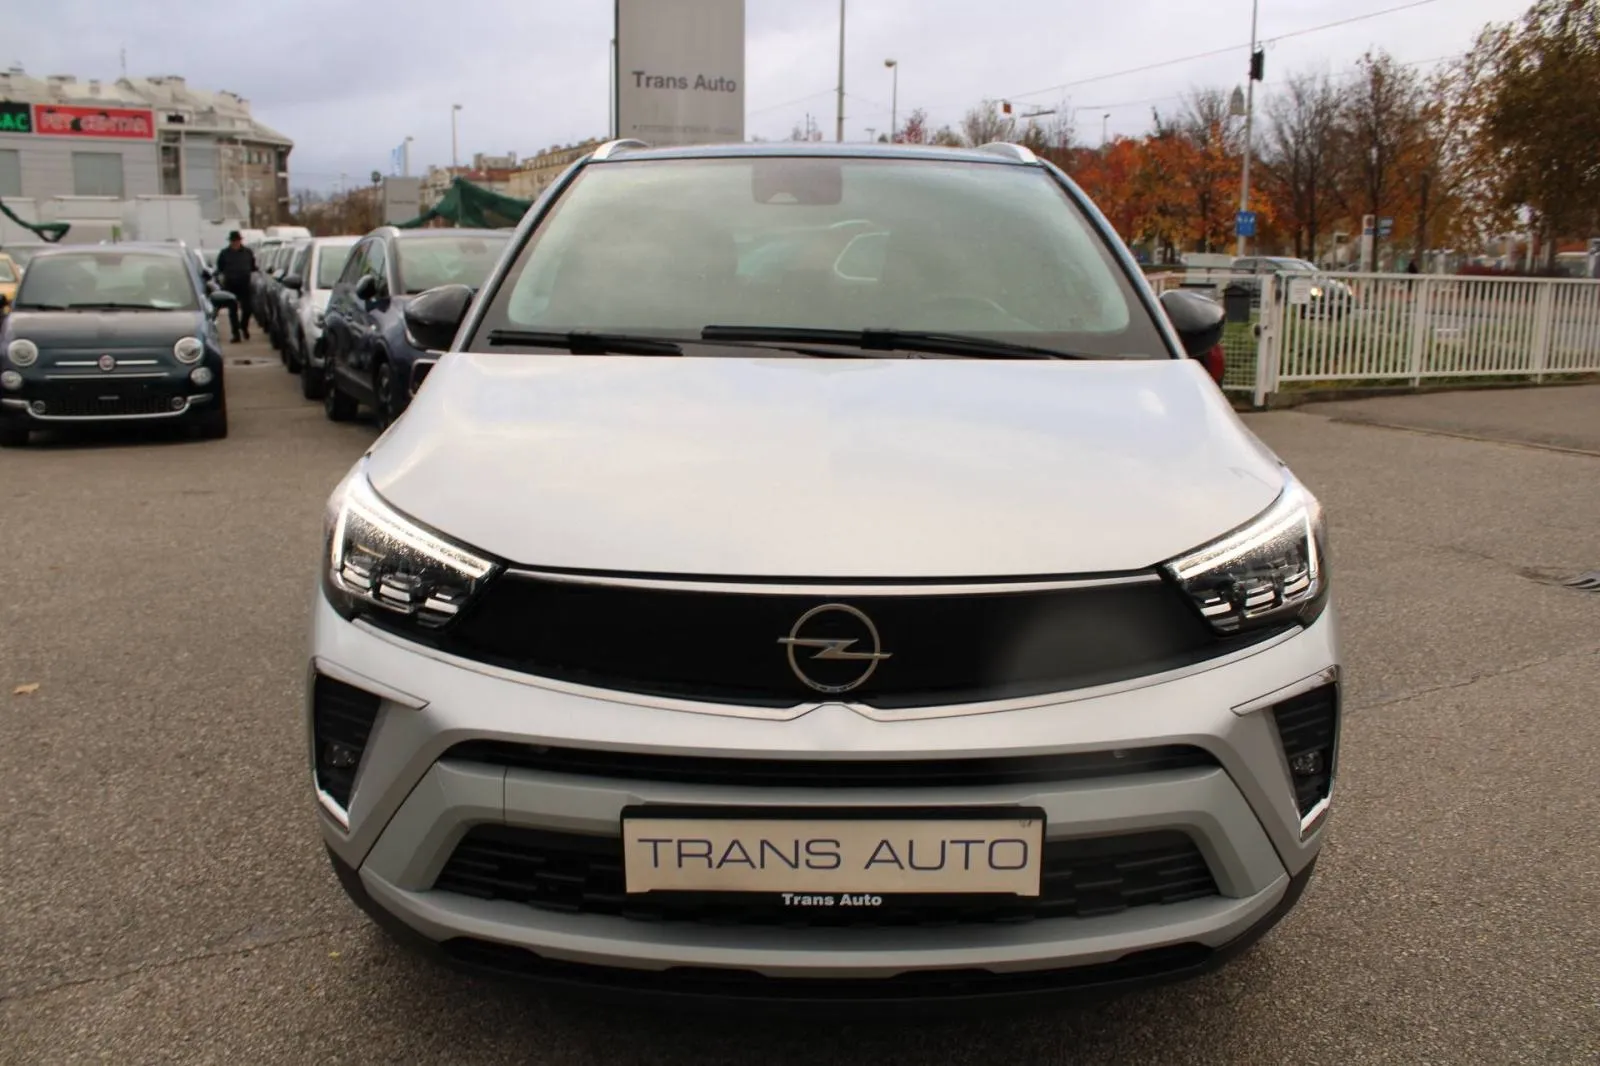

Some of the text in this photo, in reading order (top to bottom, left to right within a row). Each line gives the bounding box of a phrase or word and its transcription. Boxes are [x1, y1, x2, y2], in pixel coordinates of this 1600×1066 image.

[632, 71, 737, 93] Trans Auto
[0, 112, 28, 131] AC
[637, 838, 1029, 870] TRANS AUTO
[781, 893, 882, 906] Trans Auto
